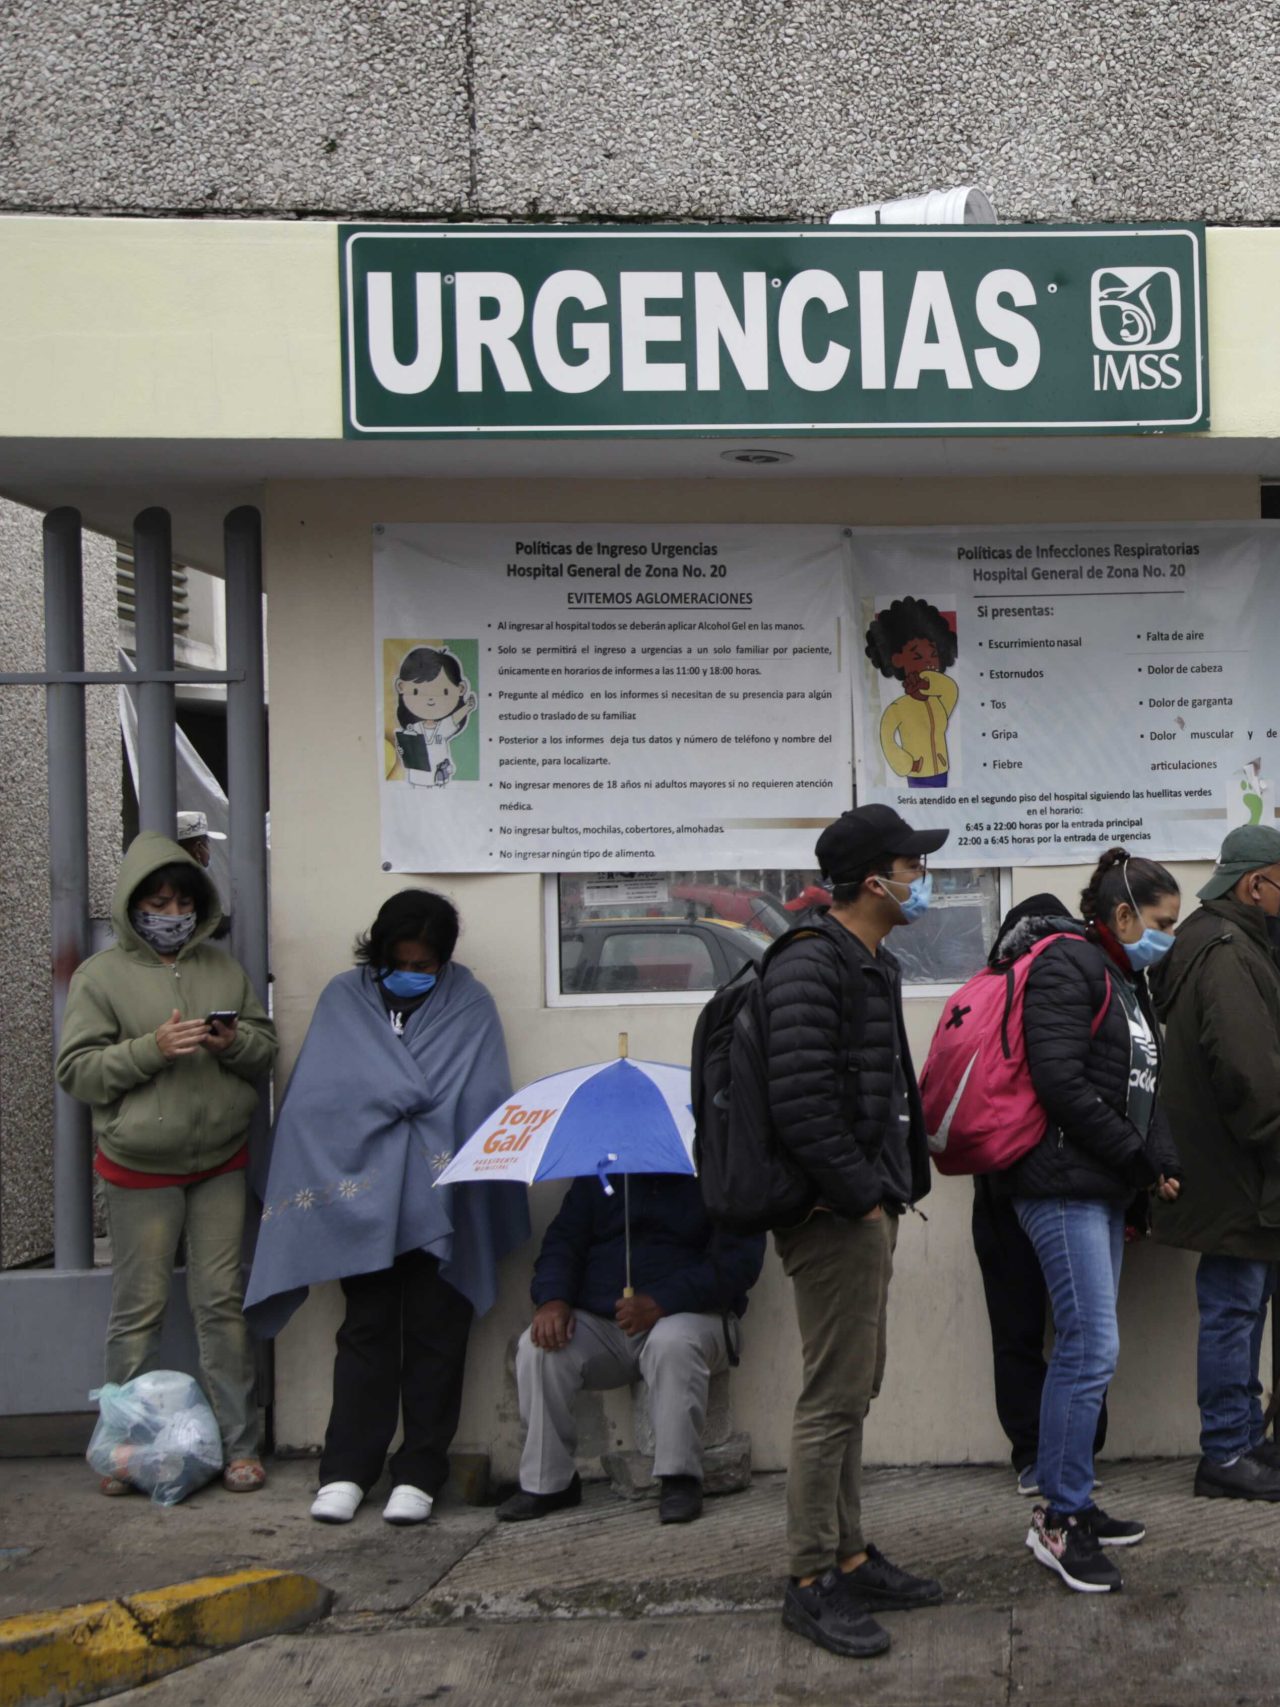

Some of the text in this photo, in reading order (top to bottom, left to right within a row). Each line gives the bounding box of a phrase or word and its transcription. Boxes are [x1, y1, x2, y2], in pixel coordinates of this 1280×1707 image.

[366, 268, 1041, 395] URGENCIAS
[1093, 353, 1182, 391] IMSS
[515, 541, 718, 559] Políticas de Ingreso Urgencias
[957, 542, 1200, 560] Políticas de Infecciones Respiratorias
[507, 563, 727, 580] Hospital General de Zona No. 20
[973, 563, 1186, 584] Hospital General de Zona No. 20
[567, 592, 753, 604] EVITEMOS AGLOMERACIONES
[977, 605, 1054, 620] Si presentas:
[497, 621, 507, 630] Al
[508, 621, 544, 632] ingresar
[545, 621, 554, 630] al
[555, 621, 591, 632] hospital
[591, 621, 617, 630] todos
[629, 621, 666, 630] deberán
[667, 621, 697, 632] aplicar
[697, 621, 730, 631] Alcohol
[731, 621, 746, 631] Gel
[748, 623, 759, 631] en
[761, 621, 773, 631] las
[774, 623, 805, 631] manos.
[1146, 630, 1204, 641] Falta de aire
[988, 637, 1082, 649] Escurrimiento nasal
[497, 645, 517, 654] Solo
[536, 645, 577, 656] permitirá
[581, 645, 589, 654] el
[594, 645, 627, 656] ingreso
[641, 645, 683, 656] urgencias
[713, 645, 732, 654] solo
[736, 645, 769, 654] familiar
[773, 647, 788, 656] por
[792, 645, 832, 656] paciente,
[498, 666, 550, 675] únicamente
[564, 666, 600, 675] horarios
[601, 666, 613, 675] de
[615, 666, 654, 675] informes
[662, 666, 674, 675] las
[676, 666, 700, 675] 11:00
[702, 669, 708, 677] y
[710, 666, 734, 675] 18:00
[735, 666, 761, 675] horas.
[989, 668, 1044, 679] Estornudos
[1147, 663, 1223, 675] Dolor de cabeza
[990, 699, 1006, 709] Tos
[1148, 697, 1233, 709] Dolor de garganta
[991, 729, 1018, 741] Gripa
[1150, 728, 1278, 741] Dolor muscular y de
[499, 756, 611, 767] paciente, para localizarte.
[993, 759, 1023, 769] Fiebre
[1150, 760, 1217, 771] articulaciones
[1039, 806, 1047, 816] el
[1049, 806, 1083, 815] horario:
[499, 824, 725, 836] No ingresar bultos, mochilas, cobertores, almohadas.
[965, 822, 984, 832] 6:45
[993, 821, 1017, 831] 22:00
[1019, 821, 1043, 830] horas
[1044, 822, 1059, 831] por
[1061, 820, 1069, 829] la
[1071, 819, 1104, 828] entrada
[1106, 817, 1143, 829] principal
[958, 836, 982, 846] 22:00
[991, 836, 1009, 845] 6:45
[1011, 835, 1035, 844] horas
[1037, 836, 1052, 845] por
[1054, 834, 1062, 843] la
[1064, 833, 1097, 842] entrada
[1098, 833, 1109, 842] de
[1111, 832, 1151, 843] urgencias
[499, 849, 655, 861] No ingresar ningún tipo de alimento.
[500, 1104, 558, 1133] Tony
